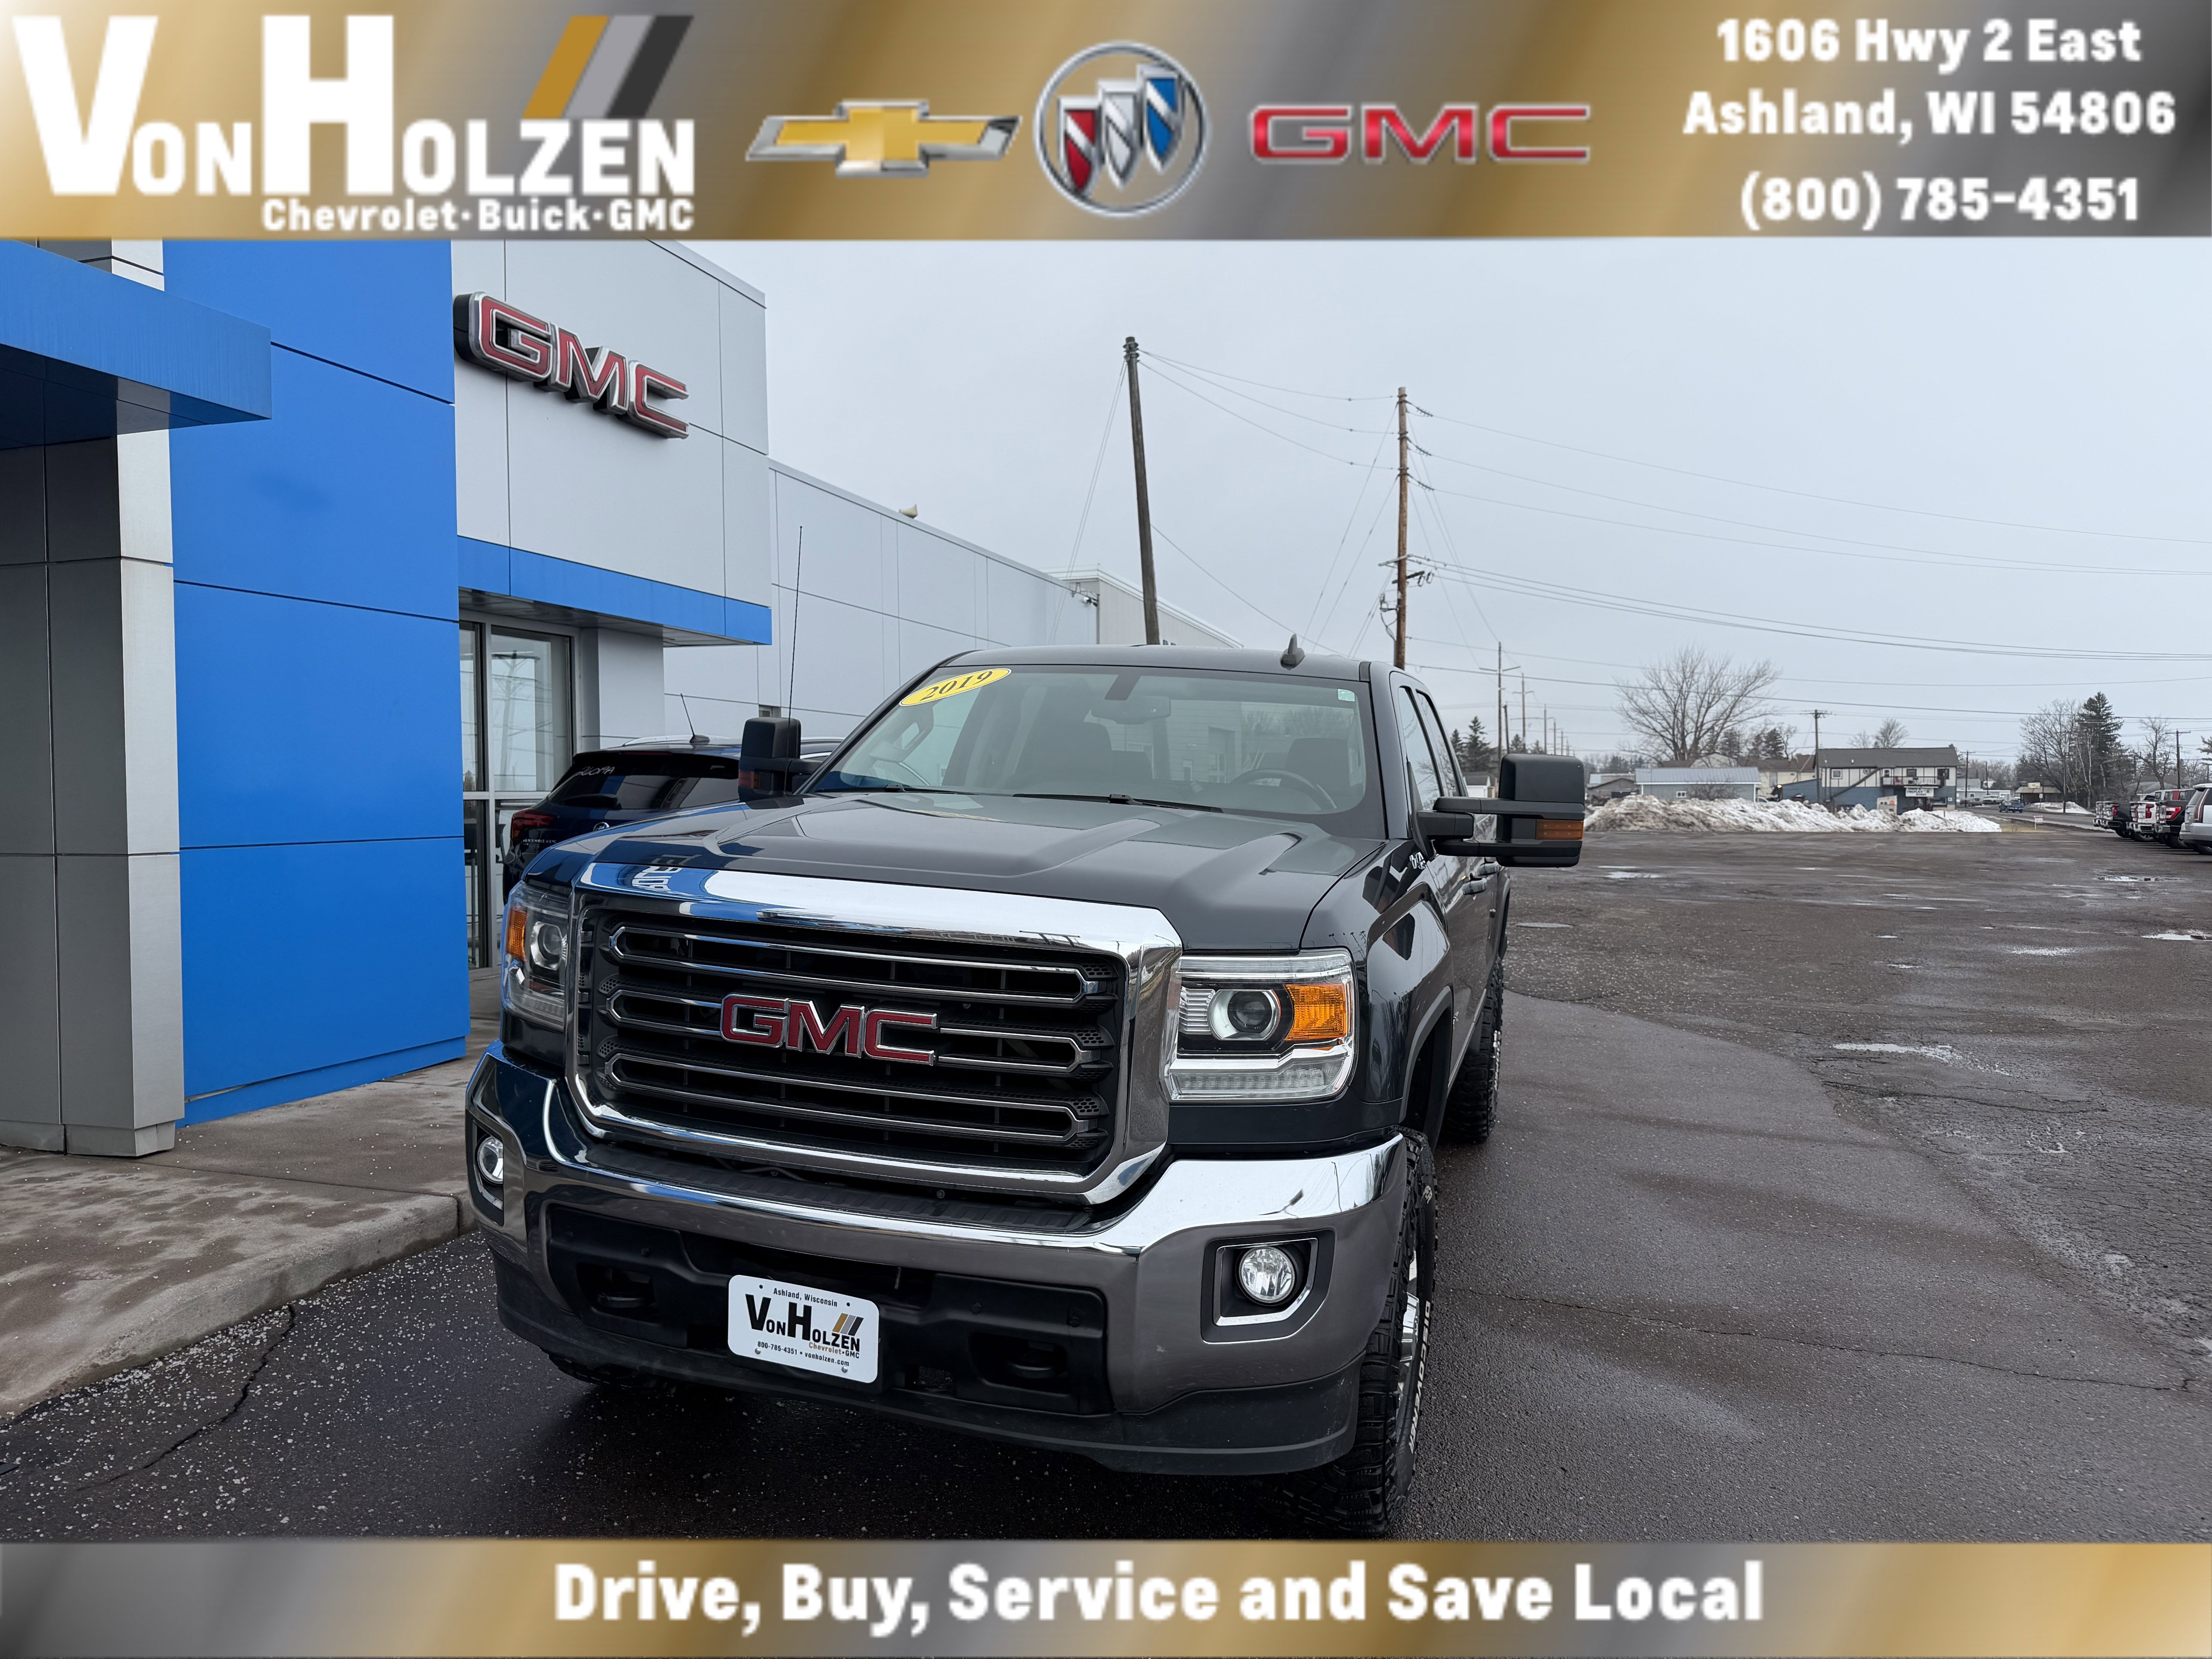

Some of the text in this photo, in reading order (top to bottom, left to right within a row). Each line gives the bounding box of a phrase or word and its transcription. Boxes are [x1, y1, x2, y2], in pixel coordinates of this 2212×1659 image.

[454, 291, 689, 439] GMC
[919, 671, 993, 702] 2019
[720, 994, 937, 1066] GMC
[773, 1288, 838, 1307] Ashland, Wisconsin
[757, 1341, 850, 1367] 800-785-4351 vonholzen.com
[1408, 1300, 1431, 1455] DISCOVERER
